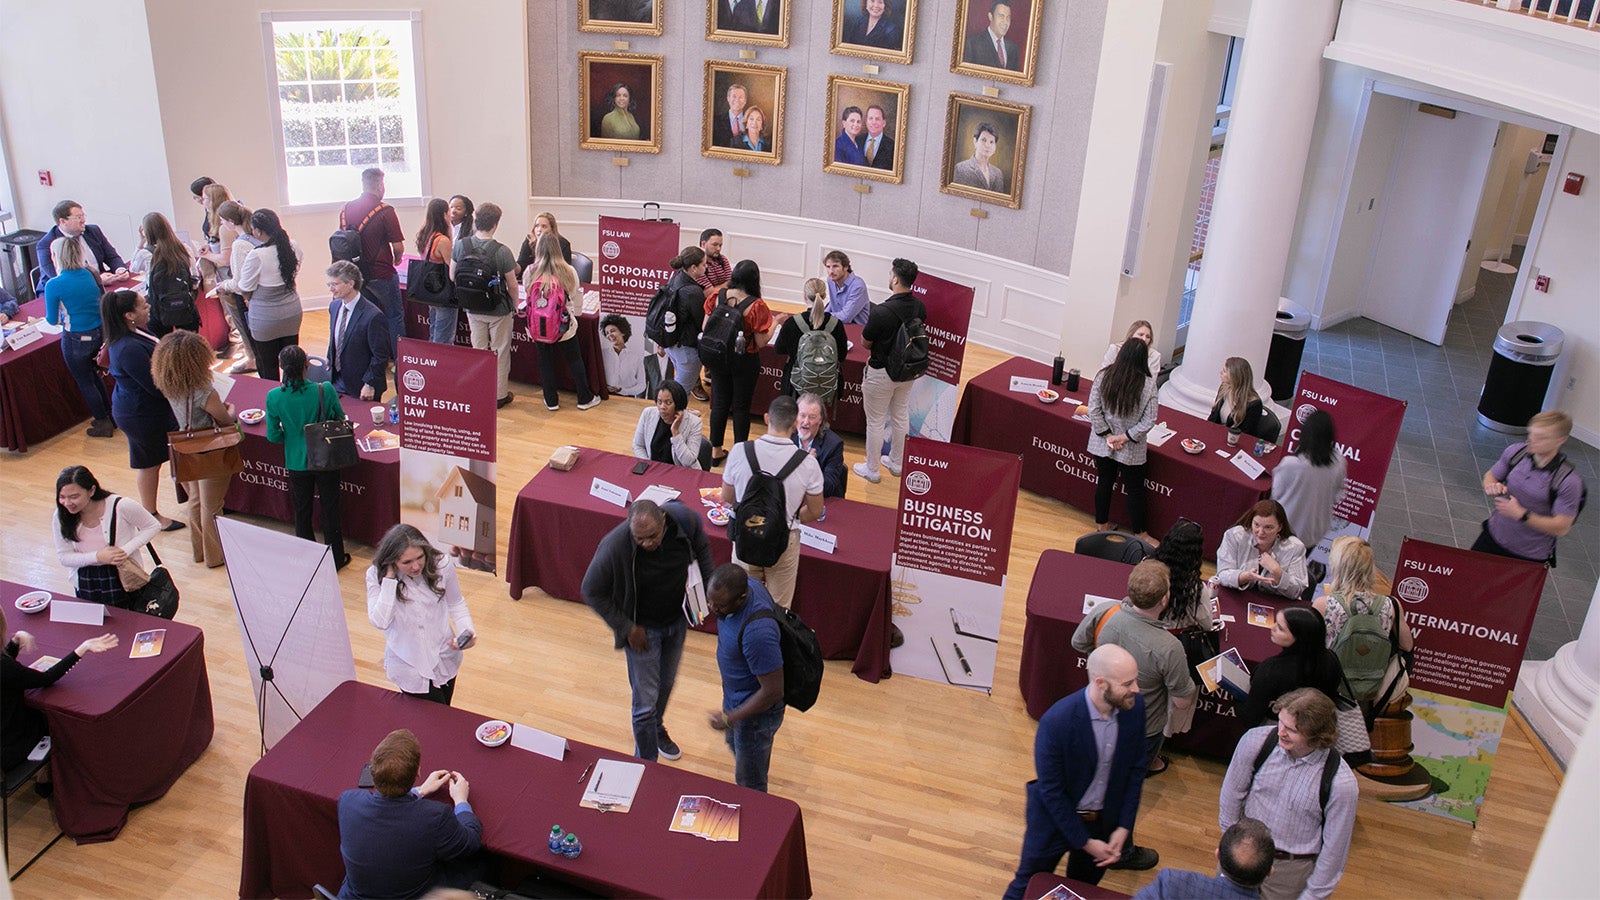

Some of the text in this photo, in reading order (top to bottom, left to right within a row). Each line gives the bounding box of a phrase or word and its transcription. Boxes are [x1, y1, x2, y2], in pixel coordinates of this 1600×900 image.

[602, 264, 674, 279] CORPORATE/
[602, 276, 660, 290] IN-HOUSE
[914, 286, 927, 295] LAW
[929, 337, 945, 348] LAW
[403, 356, 437, 367] FSU LAW
[404, 395, 470, 413] REAL ESTATE
[1302, 389, 1338, 406] FSU LAW
[404, 407, 425, 418] LAW
[256, 461, 290, 477] STATE
[909, 456, 948, 469] FSU LAW
[1032, 436, 1075, 461] FLORIDA
[1078, 453, 1098, 469] STA
[1144, 478, 1174, 497] RSITY
[240, 471, 288, 491] COLLEGE
[1353, 481, 1376, 493] protecting
[904, 498, 983, 524] BUSINESS
[903, 513, 991, 540] LITIGATION
[899, 542, 918, 550] dispute
[945, 551, 968, 559] company
[922, 534, 944, 542] business
[972, 543, 990, 552] parties
[897, 560, 919, 568] business
[898, 555, 927, 563] government
[928, 560, 952, 569] agencies,
[960, 566, 981, 575] business
[899, 548, 932, 559] shareholders,
[933, 555, 950, 563] among
[959, 560, 983, 569] directors,
[1404, 560, 1453, 576] FSU LAW
[1433, 658, 1460, 668] dealings
[1468, 665, 1492, 674] nations
[1447, 654, 1477, 664] principles
[1478, 661, 1510, 672] governing
[1412, 668, 1452, 680] nationalities,
[1466, 679, 1493, 689] between
[1415, 661, 1504, 685] relations between individuals
[1416, 675, 1457, 688] organizations
[1216, 704, 1237, 717] LA
